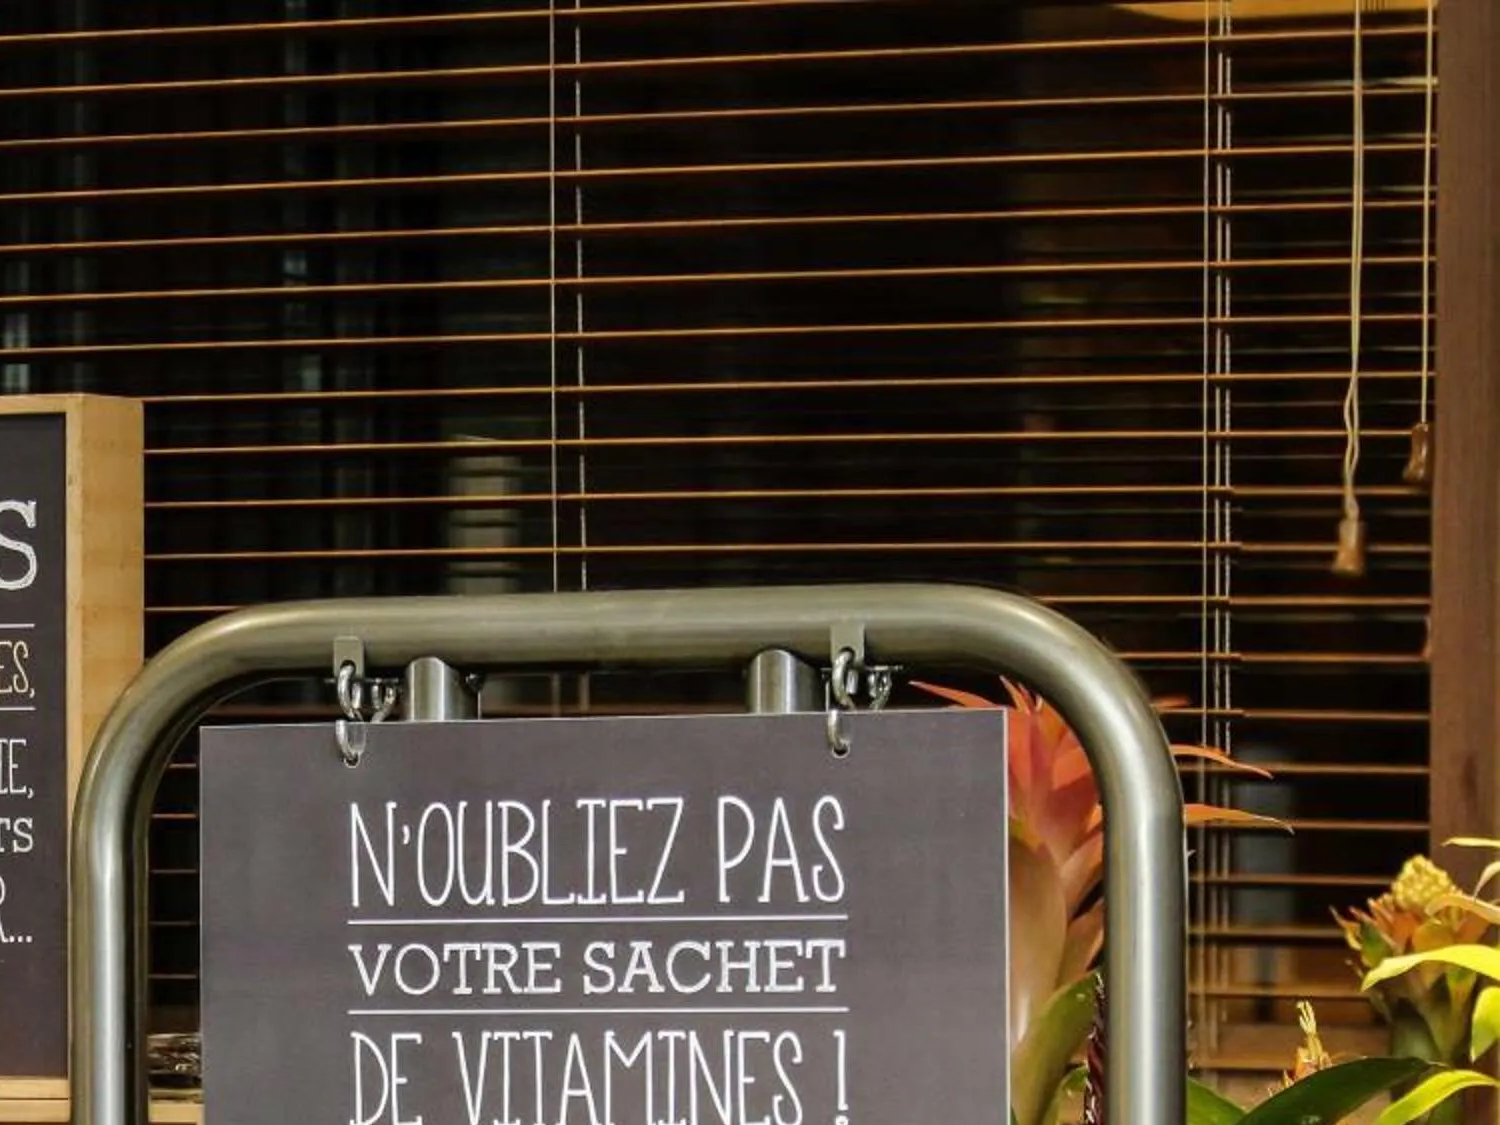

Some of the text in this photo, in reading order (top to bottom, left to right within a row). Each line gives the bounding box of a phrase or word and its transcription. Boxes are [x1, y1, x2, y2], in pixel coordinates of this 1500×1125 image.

[350, 795, 845, 908] N'OUBLIEZ PAS
[347, 938, 846, 996] VOTRE SACHET
